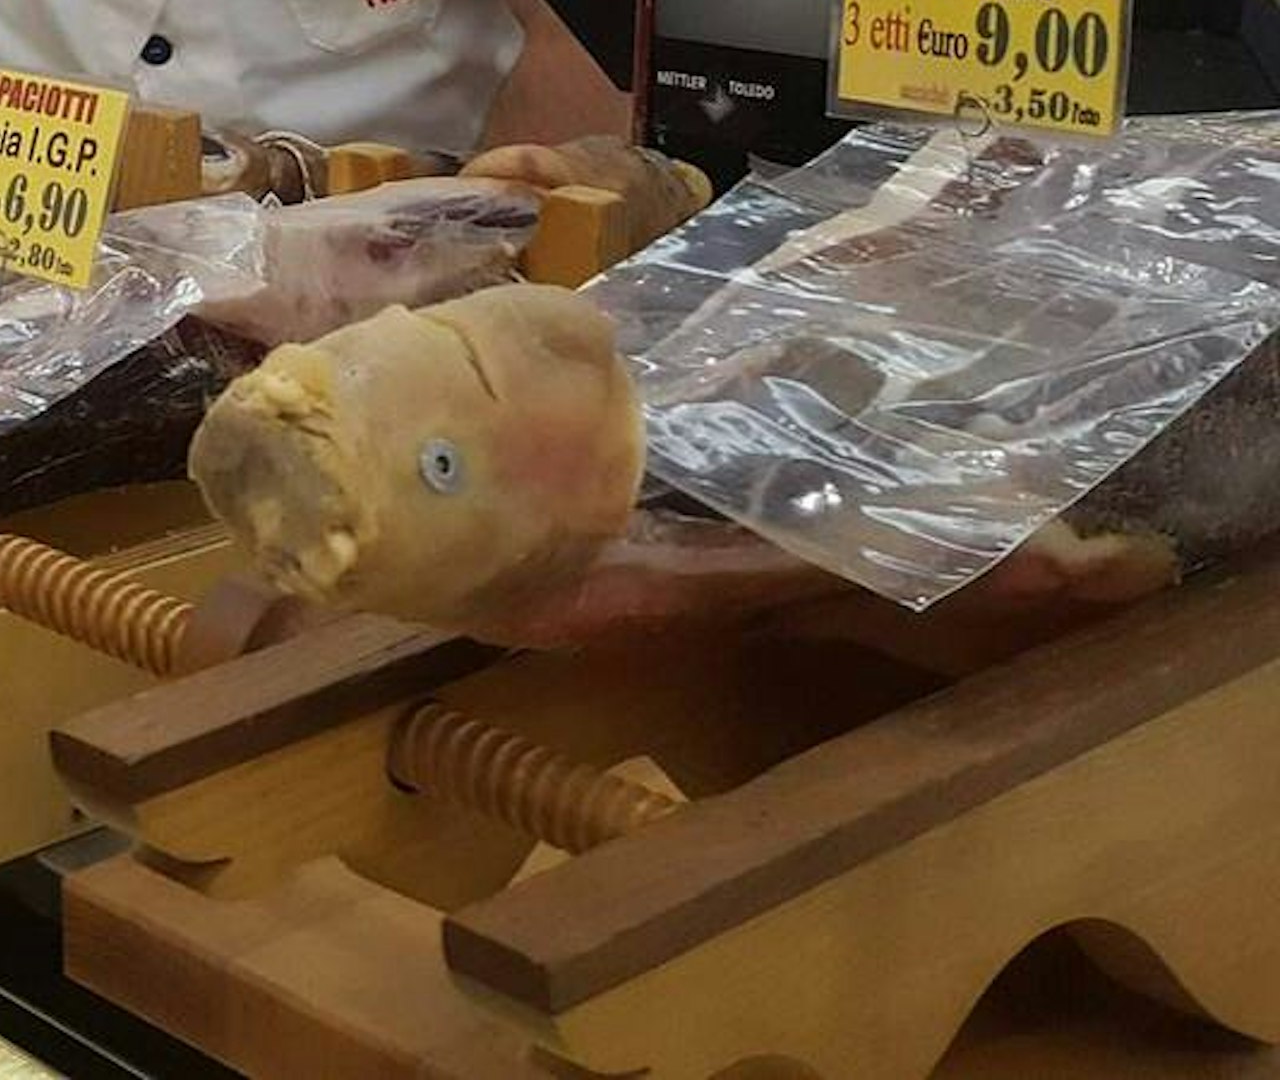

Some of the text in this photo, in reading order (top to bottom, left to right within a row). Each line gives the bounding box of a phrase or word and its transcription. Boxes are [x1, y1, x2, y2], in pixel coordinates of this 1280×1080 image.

[845, 1, 861, 46] 3
[869, 5, 910, 53] etti
[975, 1, 1109, 82] 9,00
[728, 80, 776, 100] TOLEDO
[993, 84, 1070, 122] 3,50
[27, 126, 98, 176] I.G.P.
[5, 173, 89, 239] 6,90
